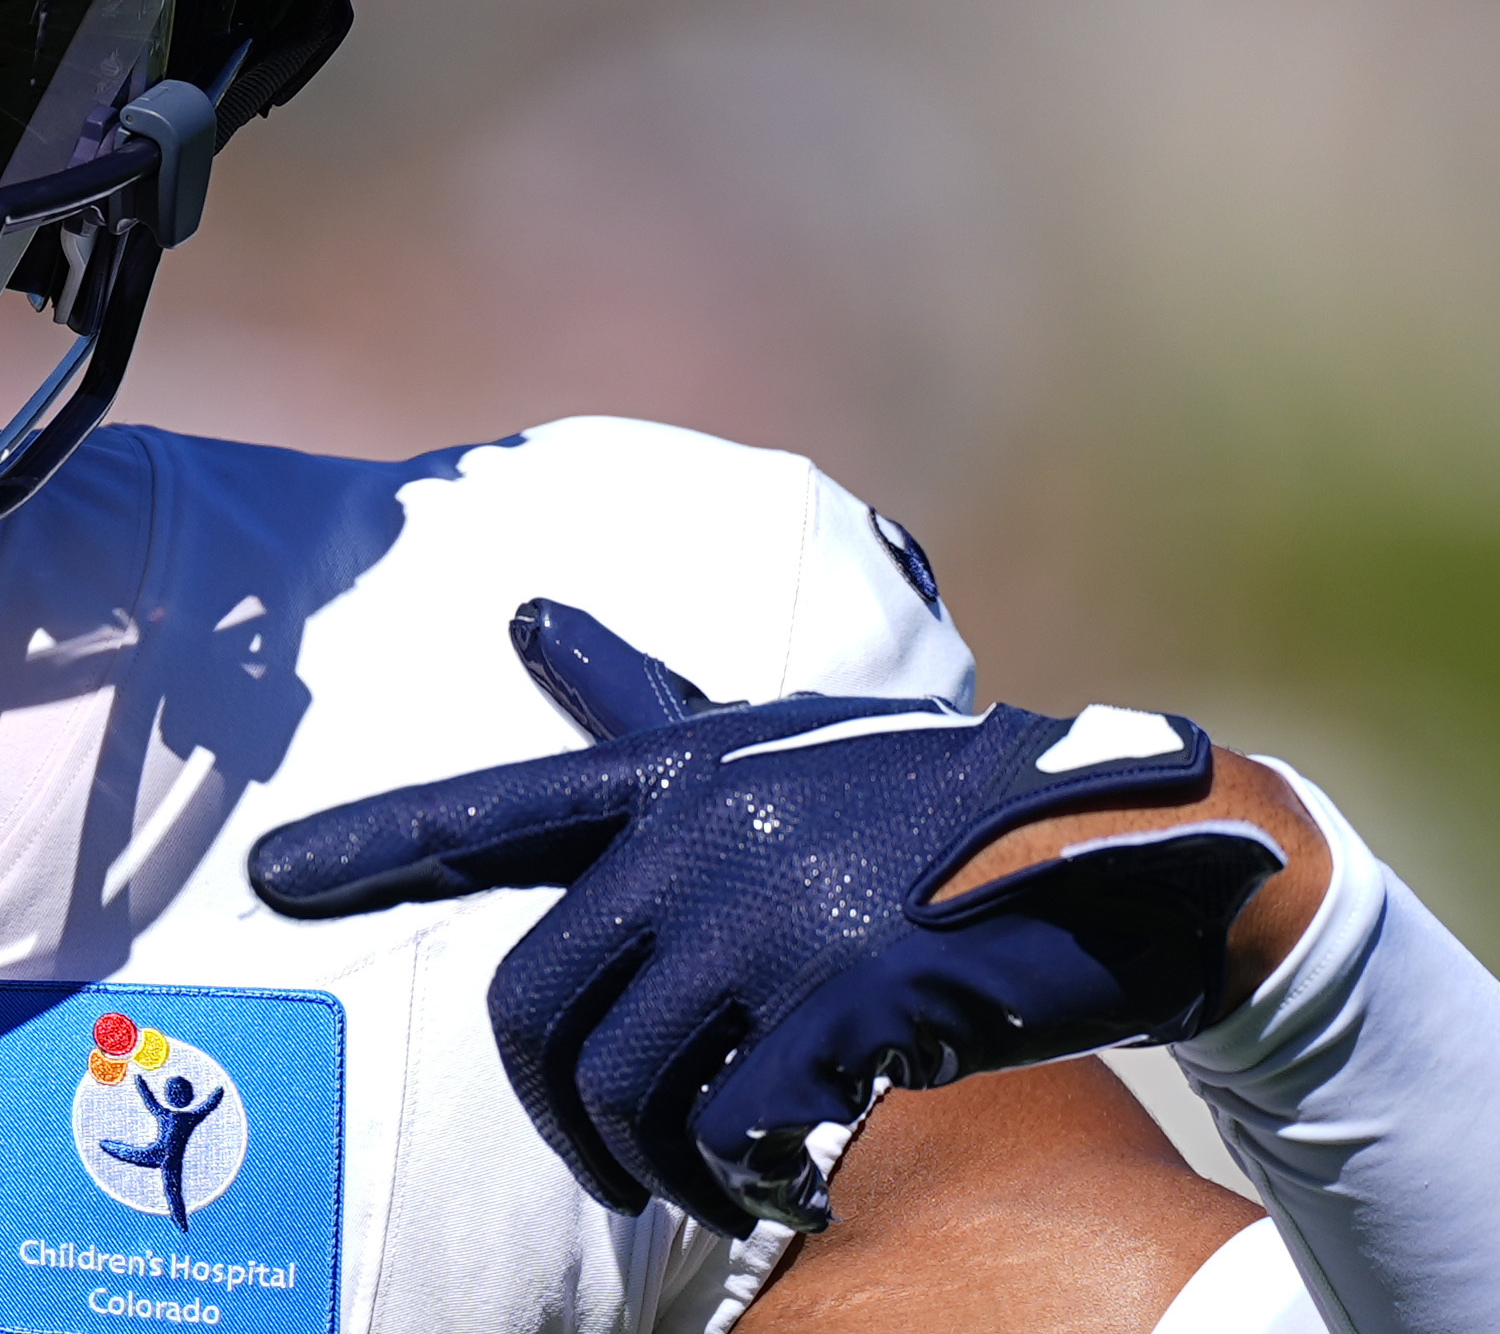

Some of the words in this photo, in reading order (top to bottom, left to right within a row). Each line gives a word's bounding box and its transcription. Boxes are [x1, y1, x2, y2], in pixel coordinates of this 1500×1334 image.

[18, 1238, 165, 1278] Children's
[170, 1252, 297, 1292] Hospital
[87, 1287, 222, 1325] Colorado
